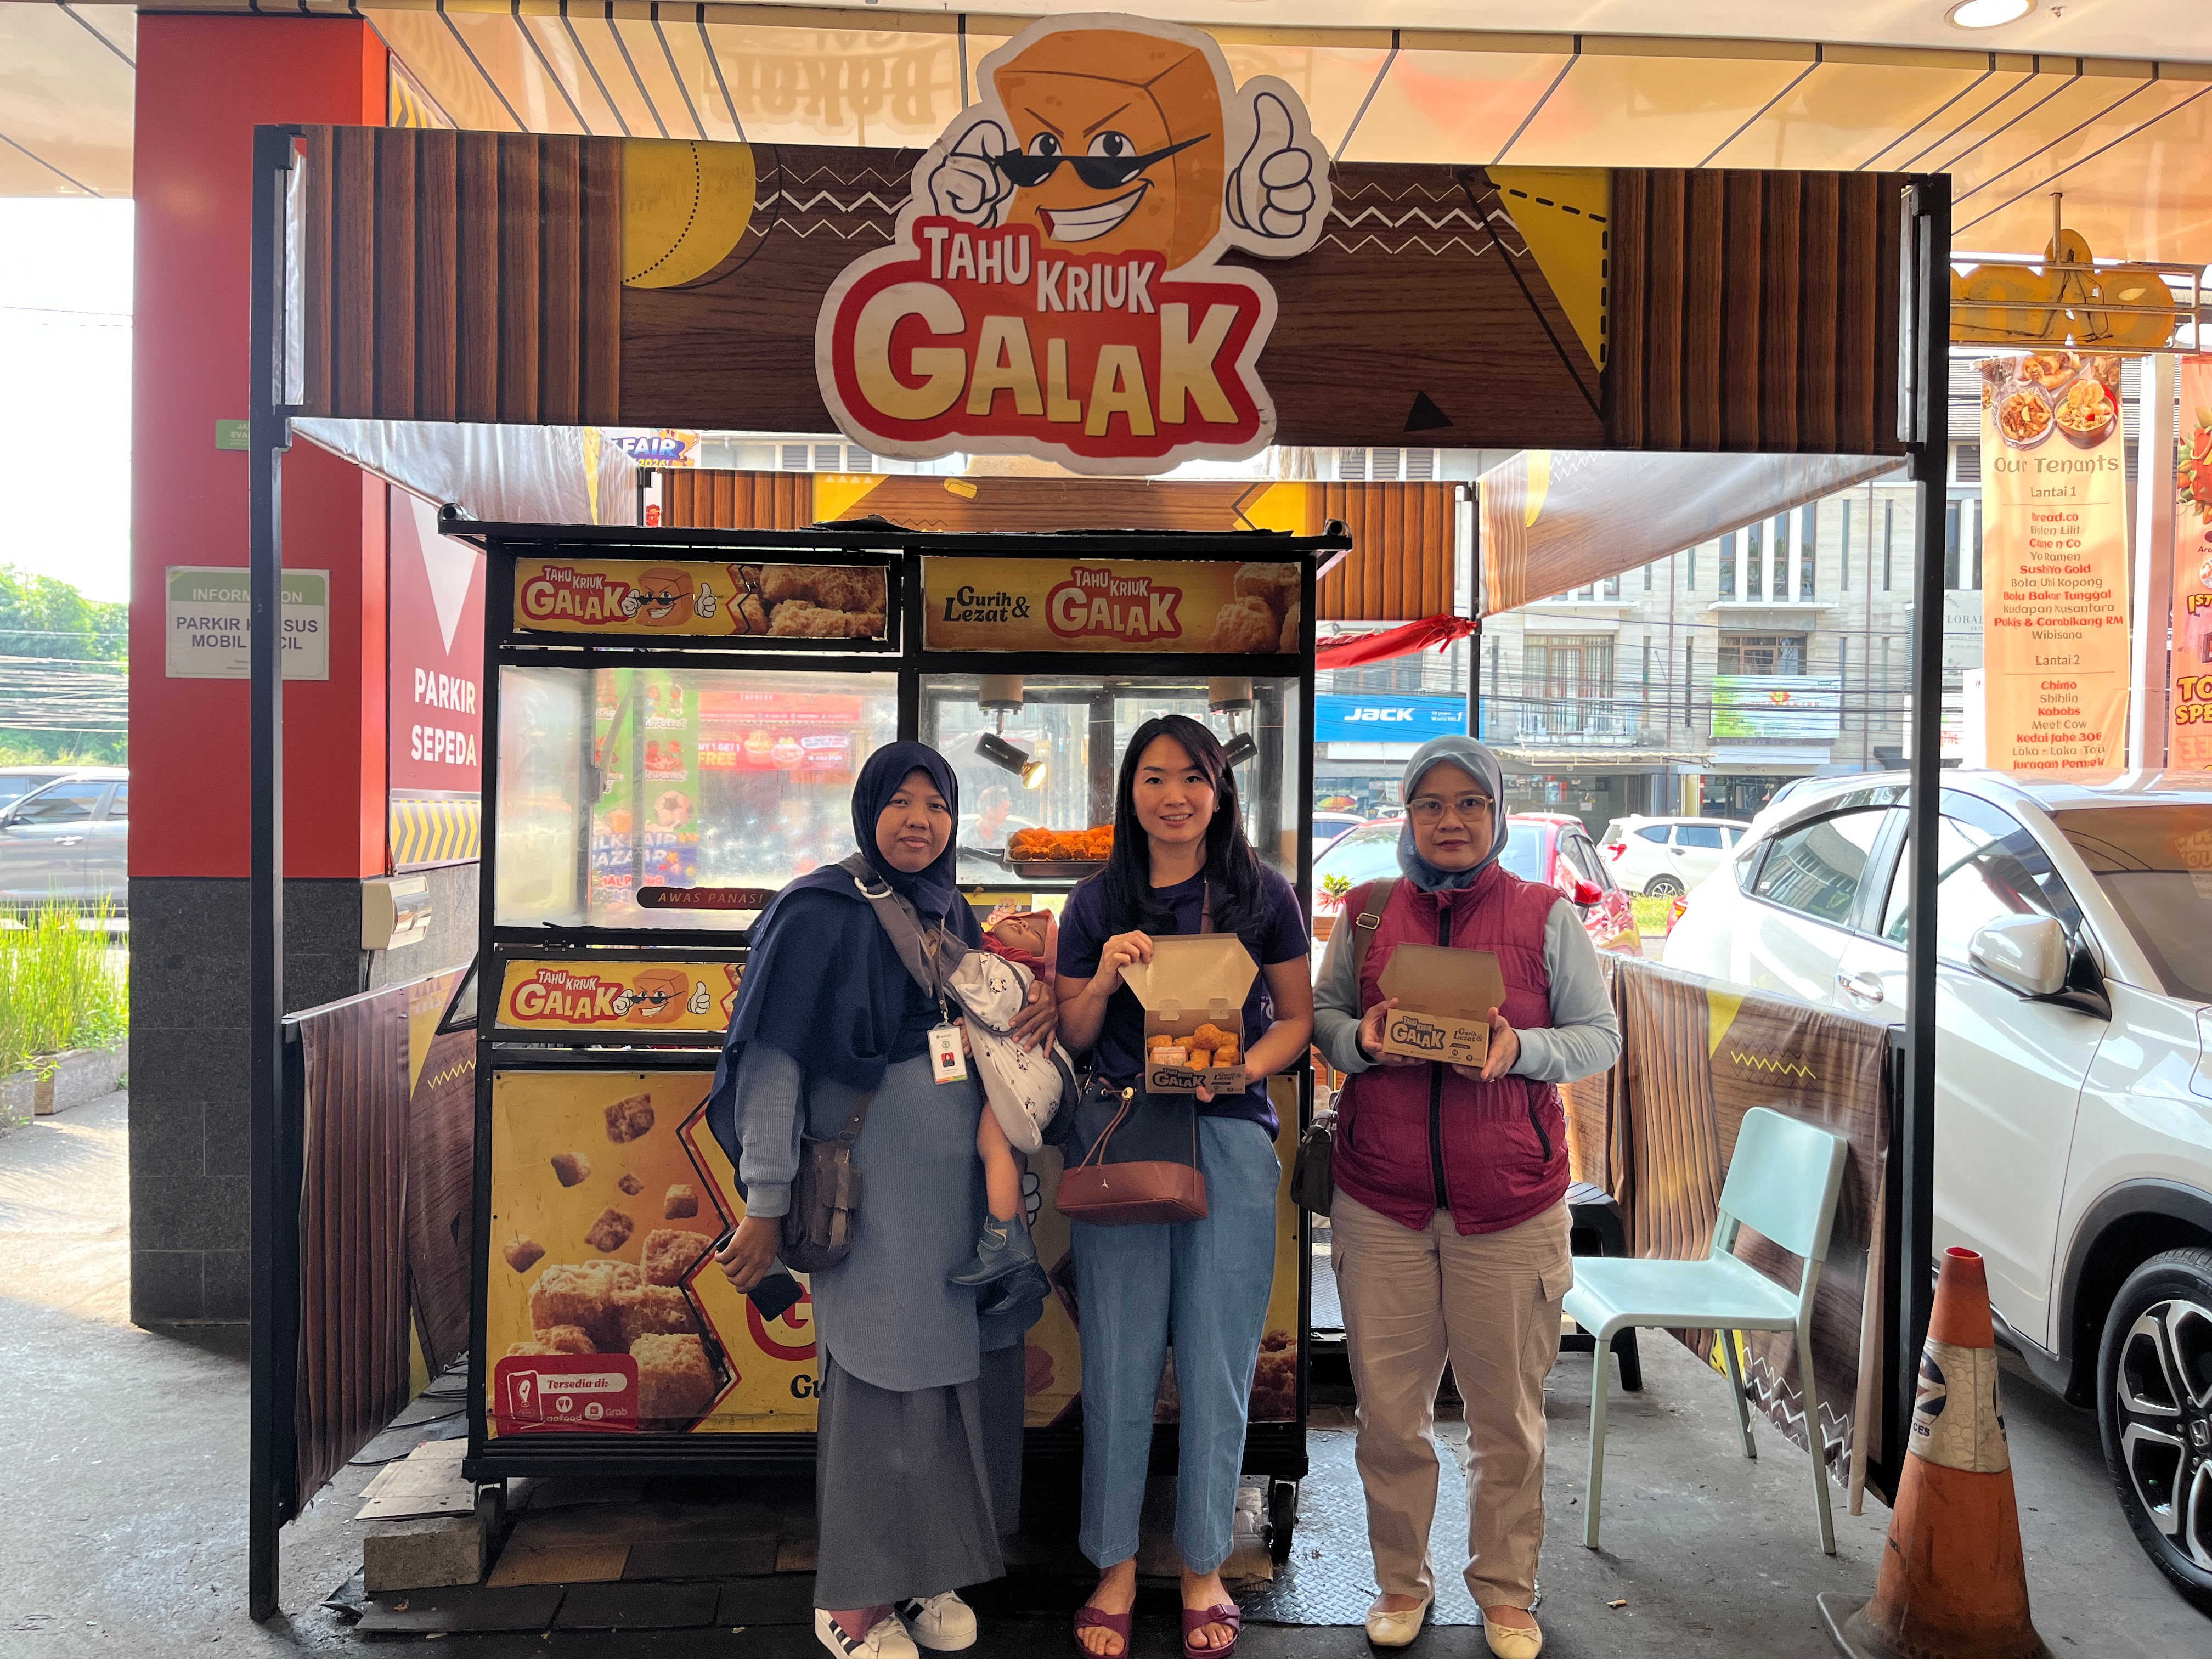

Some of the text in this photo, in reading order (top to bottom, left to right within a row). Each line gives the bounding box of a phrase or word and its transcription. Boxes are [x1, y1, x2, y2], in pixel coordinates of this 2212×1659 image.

[923, 227, 1155, 314] TAHU KRIUK
[854, 281, 1239, 437] GALAK
[622, 438, 676, 456] FAIR
[1994, 455, 2119, 474] Our Tenants
[2030, 486, 2076, 498] Lantai 1
[2032, 512, 2079, 522] Bread.co
[2030, 526, 2080, 535] Bolen Lilit
[2056, 540, 2062, 549] n
[2066, 538, 2081, 548] Co
[2064, 564, 2091, 574] Gold
[545, 568, 603, 590] TAHU KRIUK
[1074, 569, 1148, 597] TAHU KRIUK
[2011, 578, 2103, 589] Bola Ubi Kopong
[526, 581, 625, 620] GALAK
[957, 586, 1030, 618] Gurih &
[2003, 590, 2112, 602] Bolu Bakar Tunggal
[943, 597, 1008, 622] Lezat
[1052, 588, 1176, 636] GALAK
[2003, 603, 2115, 616] Kudapan Nusantara
[177, 617, 241, 631] PARKIR
[1994, 616, 2124, 628] Pukis & Carabikang RM
[192, 635, 246, 648] MOBIL
[2036, 654, 2080, 665] Lantai 2
[415, 668, 475, 715] PARKIR
[2041, 680, 2077, 691] Chimo
[2040, 693, 2078, 703] Shihlin
[2038, 707, 2081, 716] Kabobs
[2032, 720, 2087, 730] Meet Cow
[2017, 732, 2102, 744] Kedai Jahe 306
[411, 724, 477, 766] SEPEDA
[698, 743, 710, 751] UY
[2013, 747, 2039, 756] Laka
[2050, 746, 2077, 755] Laka
[698, 752, 736, 765] FREE
[658, 893, 763, 904] AWAS PANAS!
[539, 971, 597, 990] TAHU KRIUK
[515, 983, 618, 1019] GALAK
[1403, 1017, 1434, 1031] TAHU KRIUK
[1392, 1023, 1443, 1048] GALAK
[1453, 1031, 1475, 1042] Lezat
[1459, 1028, 1477, 1037] Gurih
[1154, 1073, 1206, 1087] GALAK
[547, 1378, 608, 1389] Tersedia di:
[605, 1407, 628, 1416] Grab
